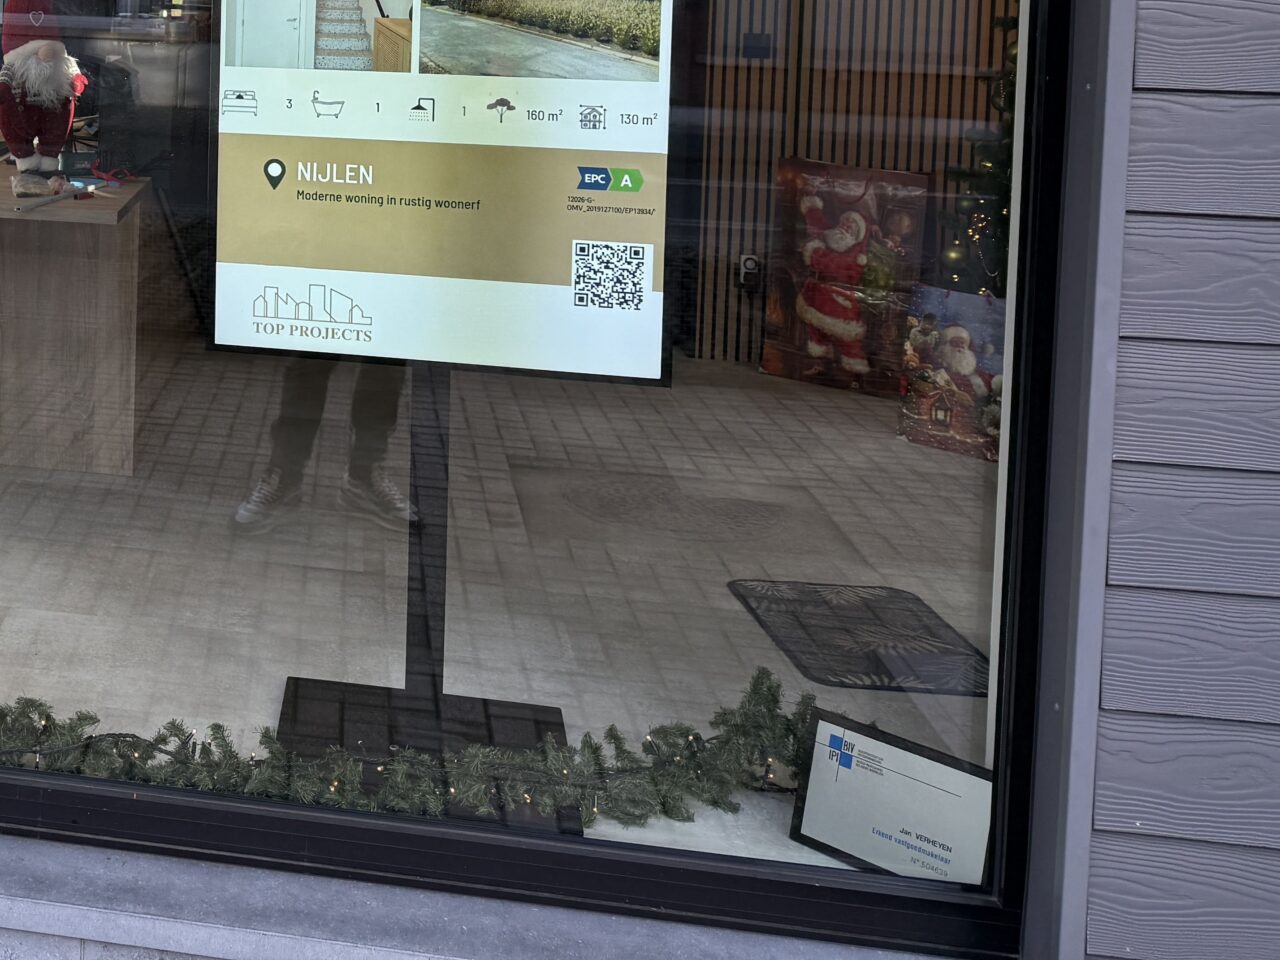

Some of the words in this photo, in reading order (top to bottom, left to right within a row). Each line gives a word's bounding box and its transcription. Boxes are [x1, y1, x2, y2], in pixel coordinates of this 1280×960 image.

[285, 98, 293, 109] 3
[375, 102, 380, 113] 1
[526, 109, 545, 121] 160
[619, 113, 639, 125] 130
[297, 161, 374, 185] NIJLEN
[584, 173, 606, 184] EPC
[620, 174, 632, 188] A
[296, 190, 342, 203] Moderne
[345, 193, 384, 208] woning
[386, 194, 396, 206] in
[399, 196, 432, 210] rustig
[434, 199, 481, 211] woonerf
[252, 321, 285, 335] TOP
[289, 324, 373, 343] PROJECTS
[842, 739, 856, 753] BIV
[828, 749, 839, 763] IPI
[871, 826, 893, 841] Erkend
[894, 837, 952, 865] vastgoedmakelaar
[899, 827, 912, 837] Jan
[915, 832, 953, 853] VERHEYEN
